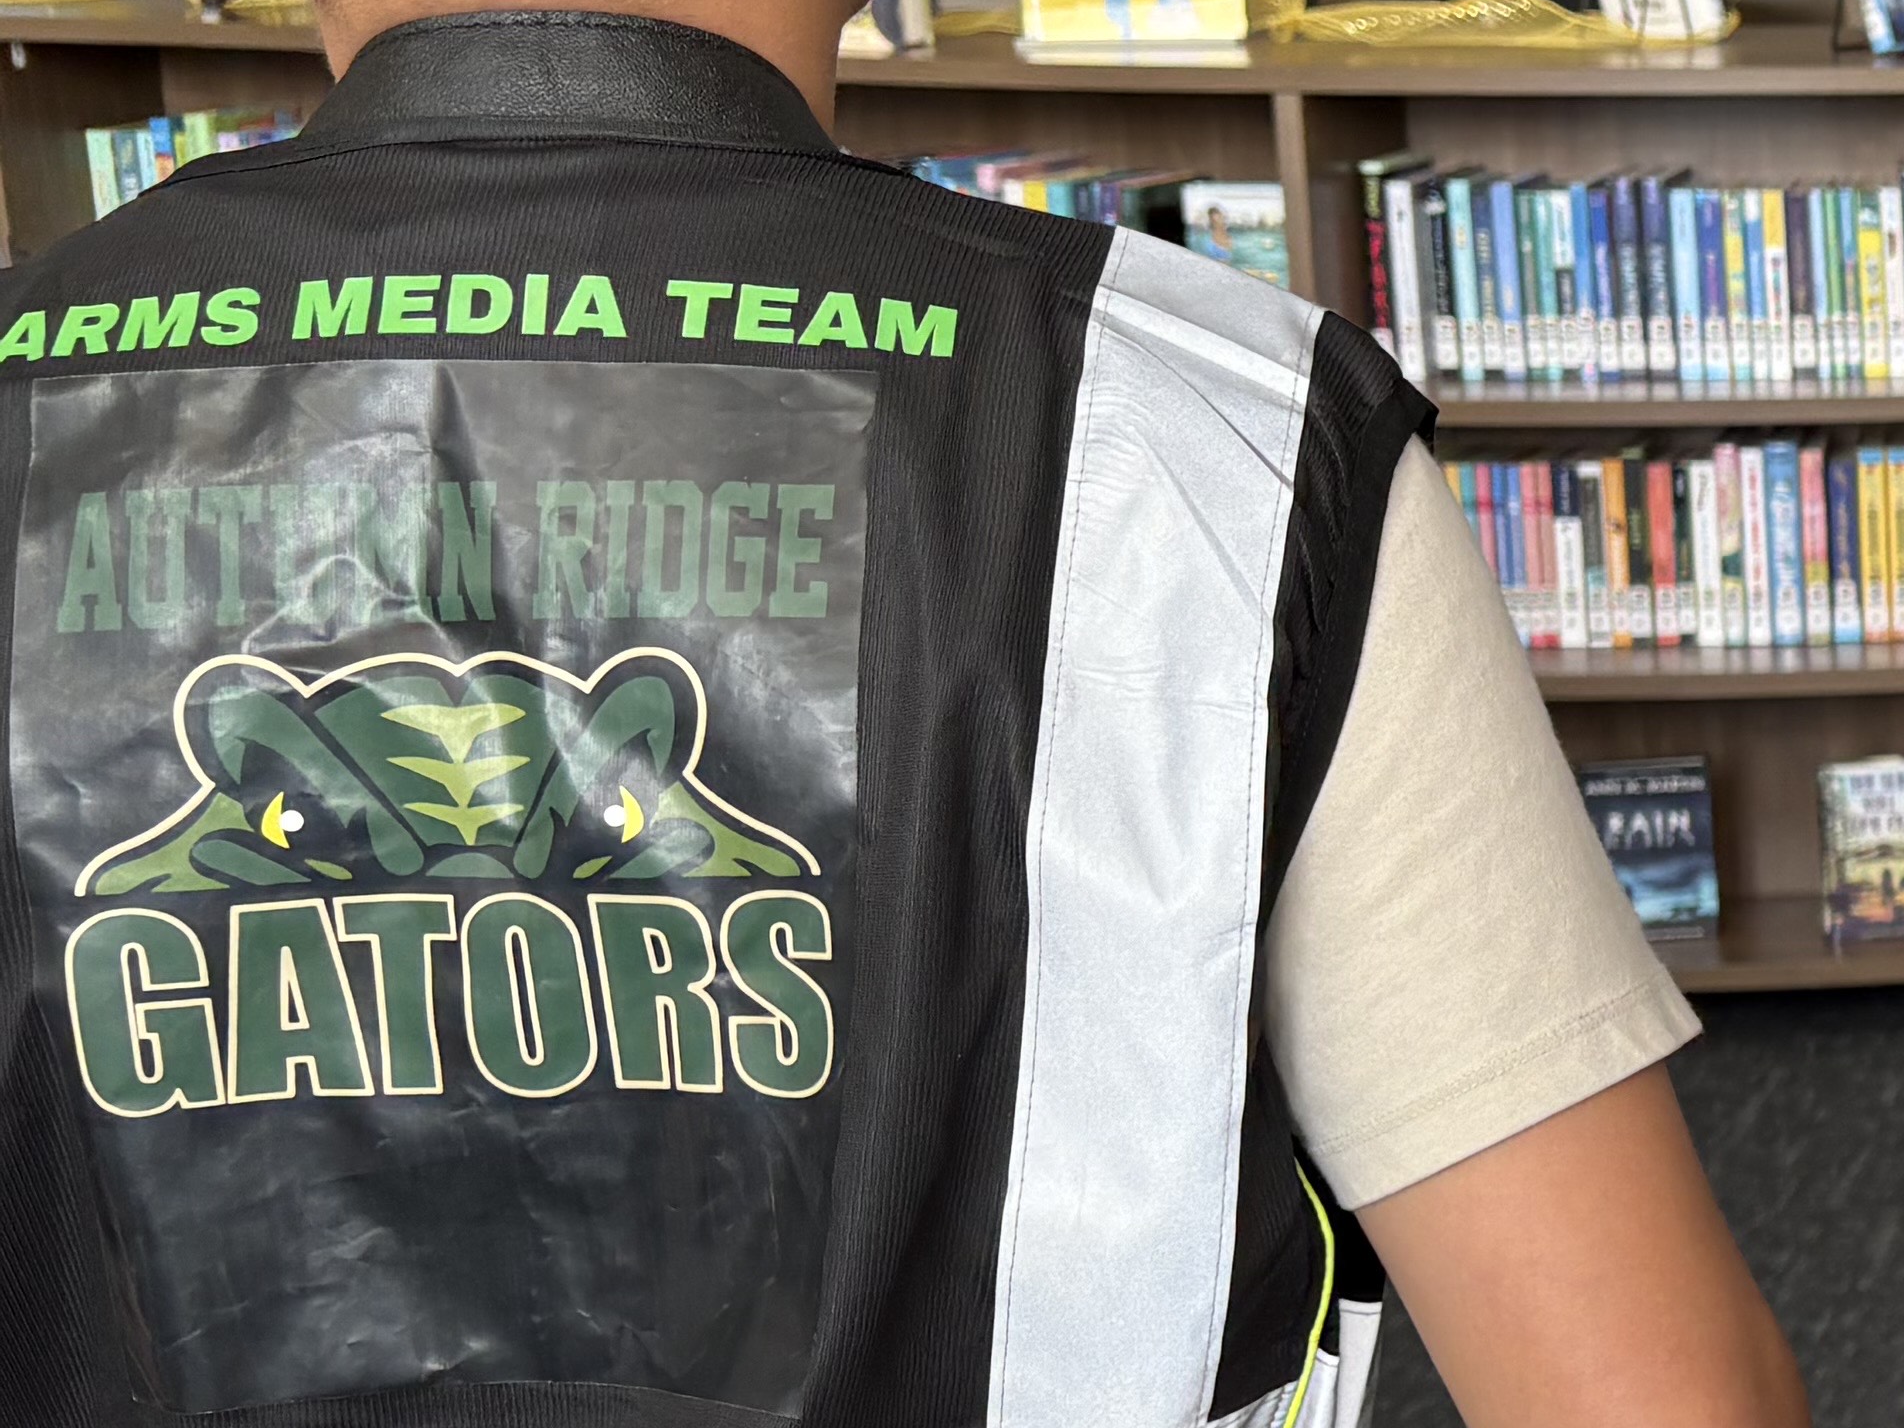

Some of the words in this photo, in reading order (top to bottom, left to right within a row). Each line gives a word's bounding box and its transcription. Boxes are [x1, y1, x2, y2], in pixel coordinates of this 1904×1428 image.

[0, 287, 259, 362] ARMS
[291, 274, 628, 339] MEDIA
[666, 280, 958, 357] TEAM
[533, 479, 834, 621] RIDGE
[65, 890, 833, 1118] GATORS
